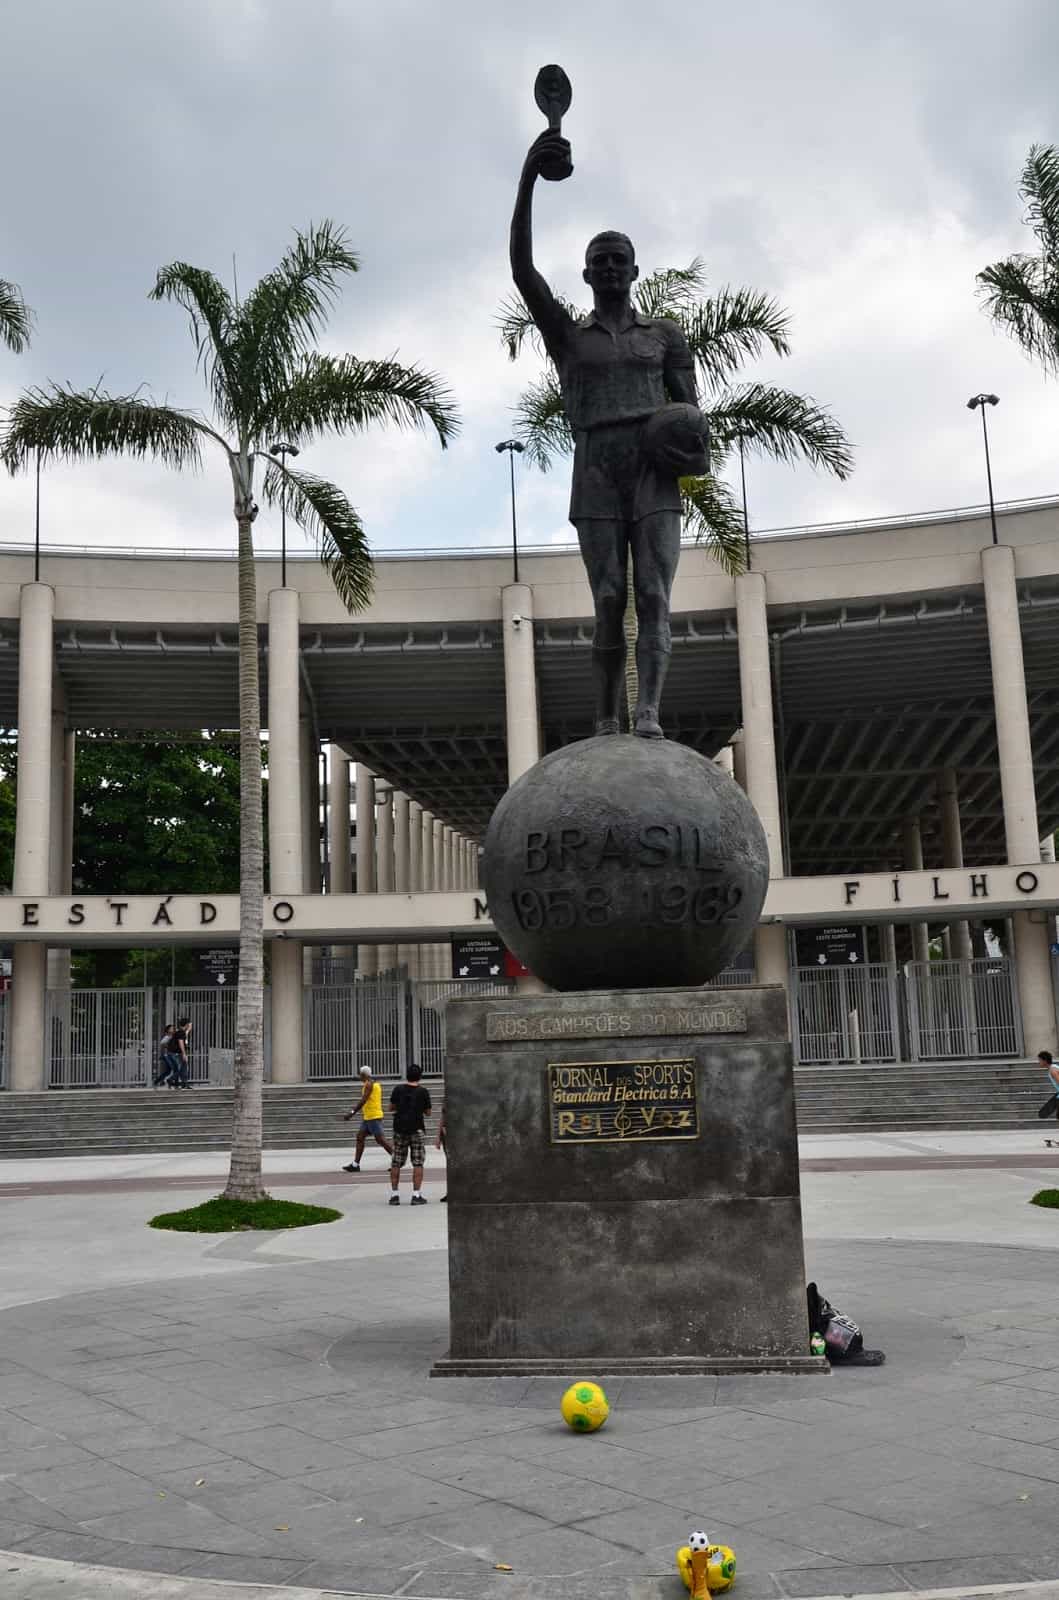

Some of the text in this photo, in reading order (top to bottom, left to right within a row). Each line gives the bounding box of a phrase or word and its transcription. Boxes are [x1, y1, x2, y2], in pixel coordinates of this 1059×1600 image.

[525, 824, 725, 875] BRASIL
[22, 896, 294, 925] ESTÁDO
[552, 1067, 613, 1088] JORNAL
[633, 1063, 694, 1086] SPORTS
[553, 1088, 611, 1104] Standard
[614, 1085, 667, 1102] Electrica
